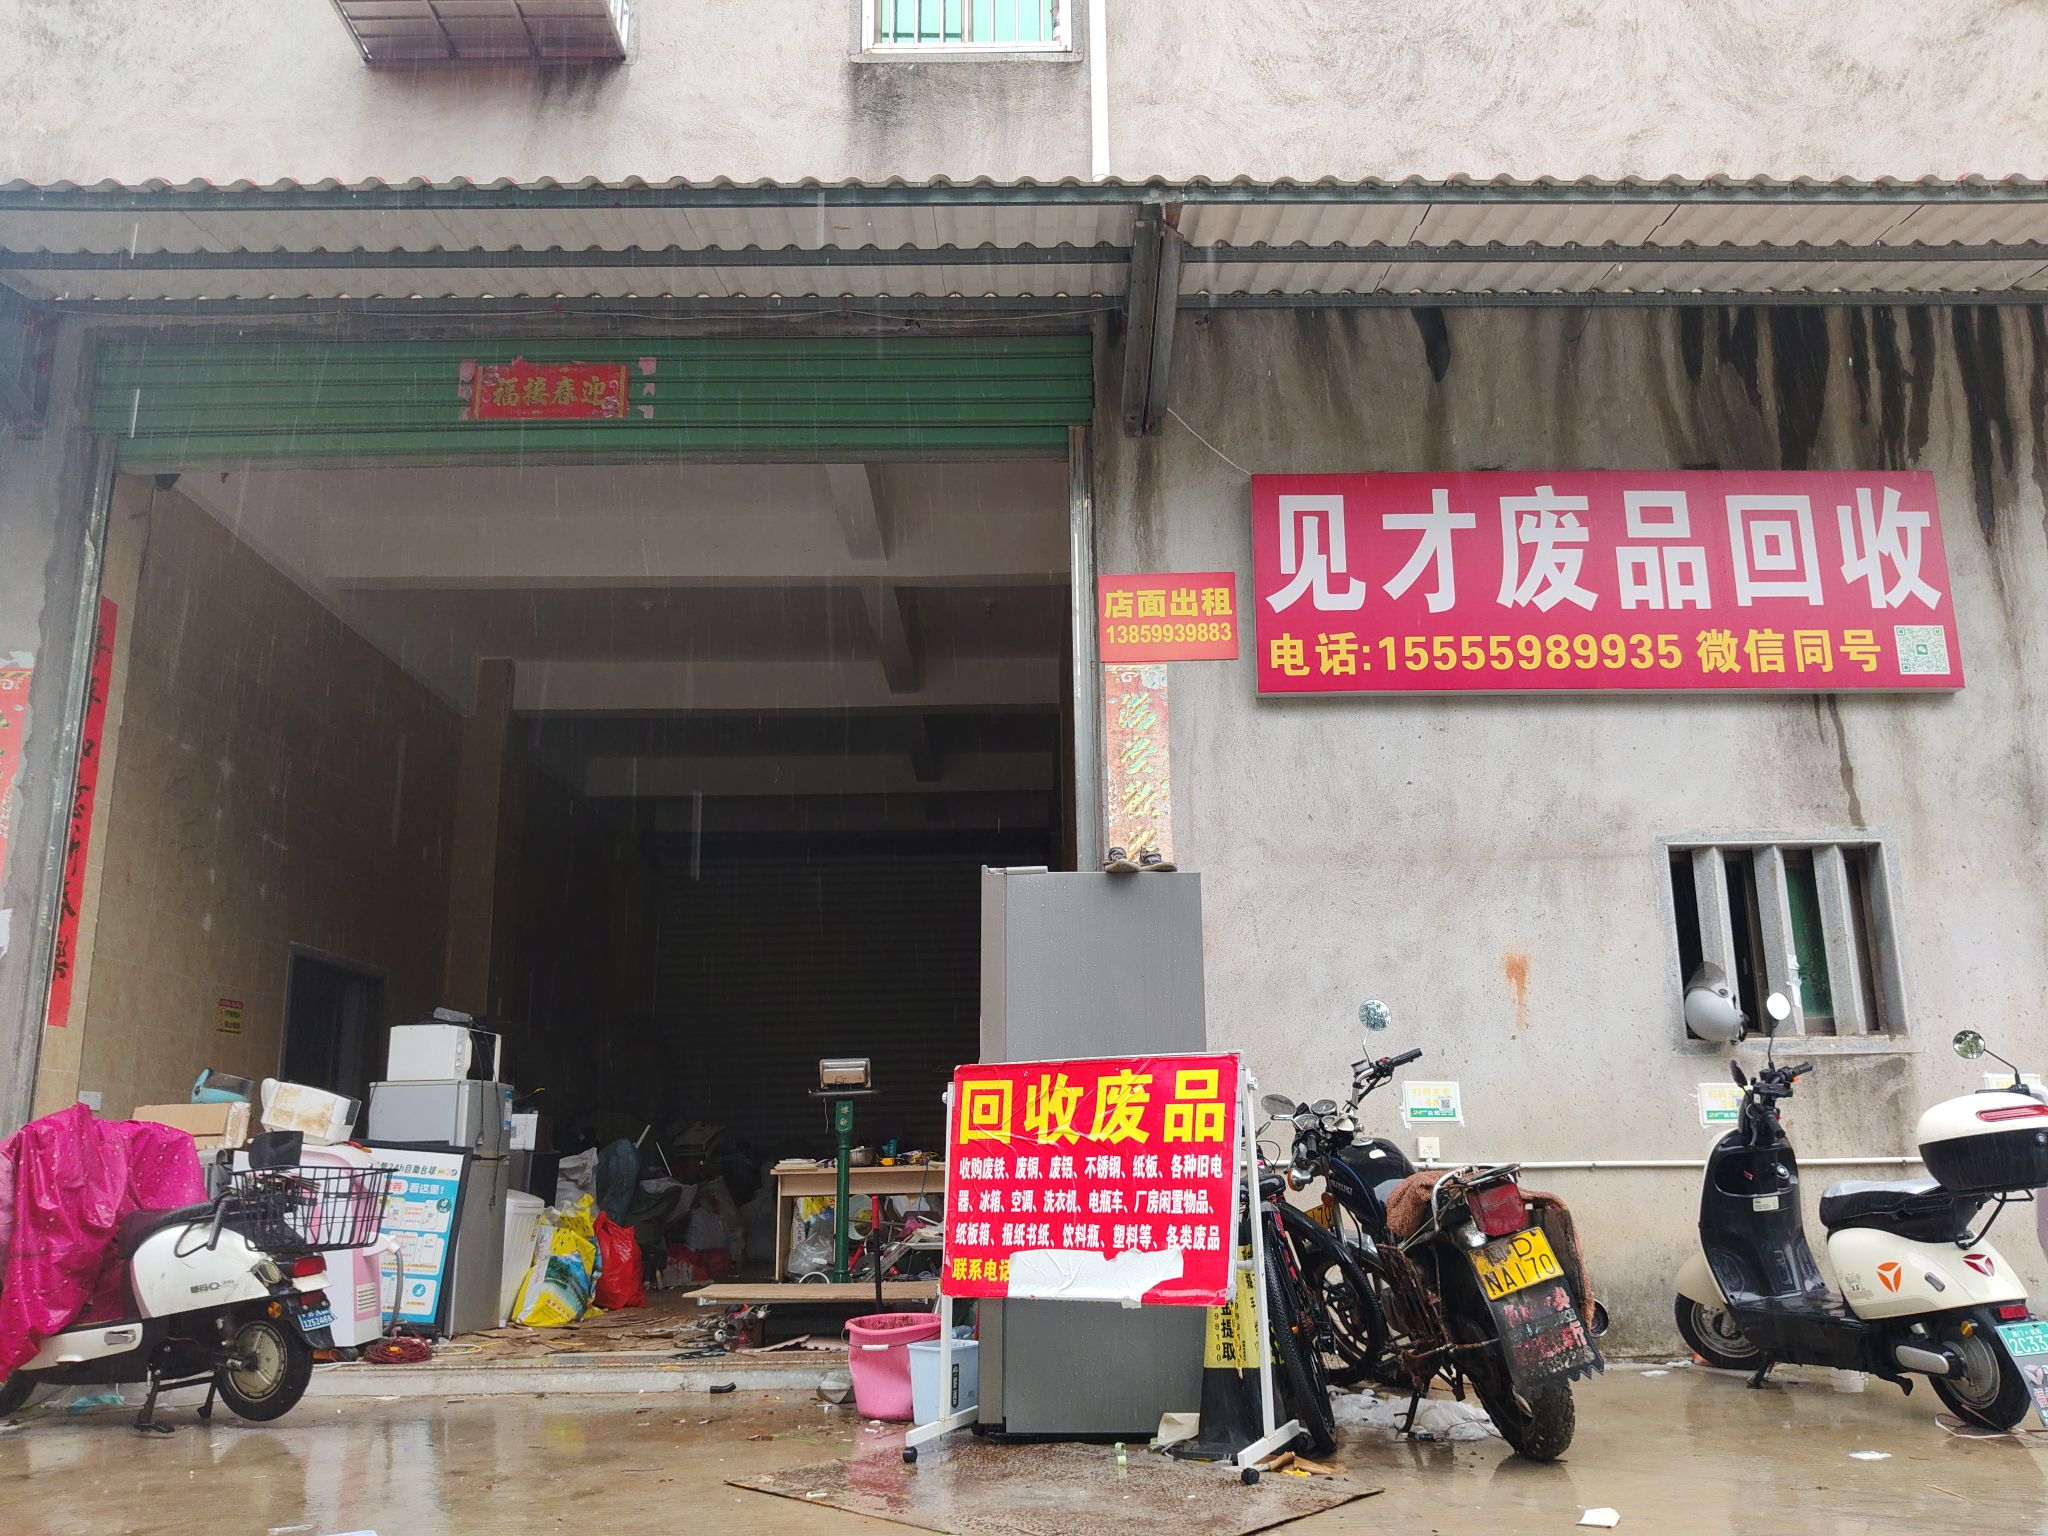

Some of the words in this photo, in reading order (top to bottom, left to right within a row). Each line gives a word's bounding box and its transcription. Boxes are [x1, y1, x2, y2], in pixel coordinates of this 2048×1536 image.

[1266, 485, 1942, 614] 见才废品回收
[1104, 588, 1232, 618] 店面出租
[1106, 623, 1232, 644] 13859939883
[1696, 628, 1882, 673] 微信同号
[959, 1068, 1226, 1145] 回收废品
